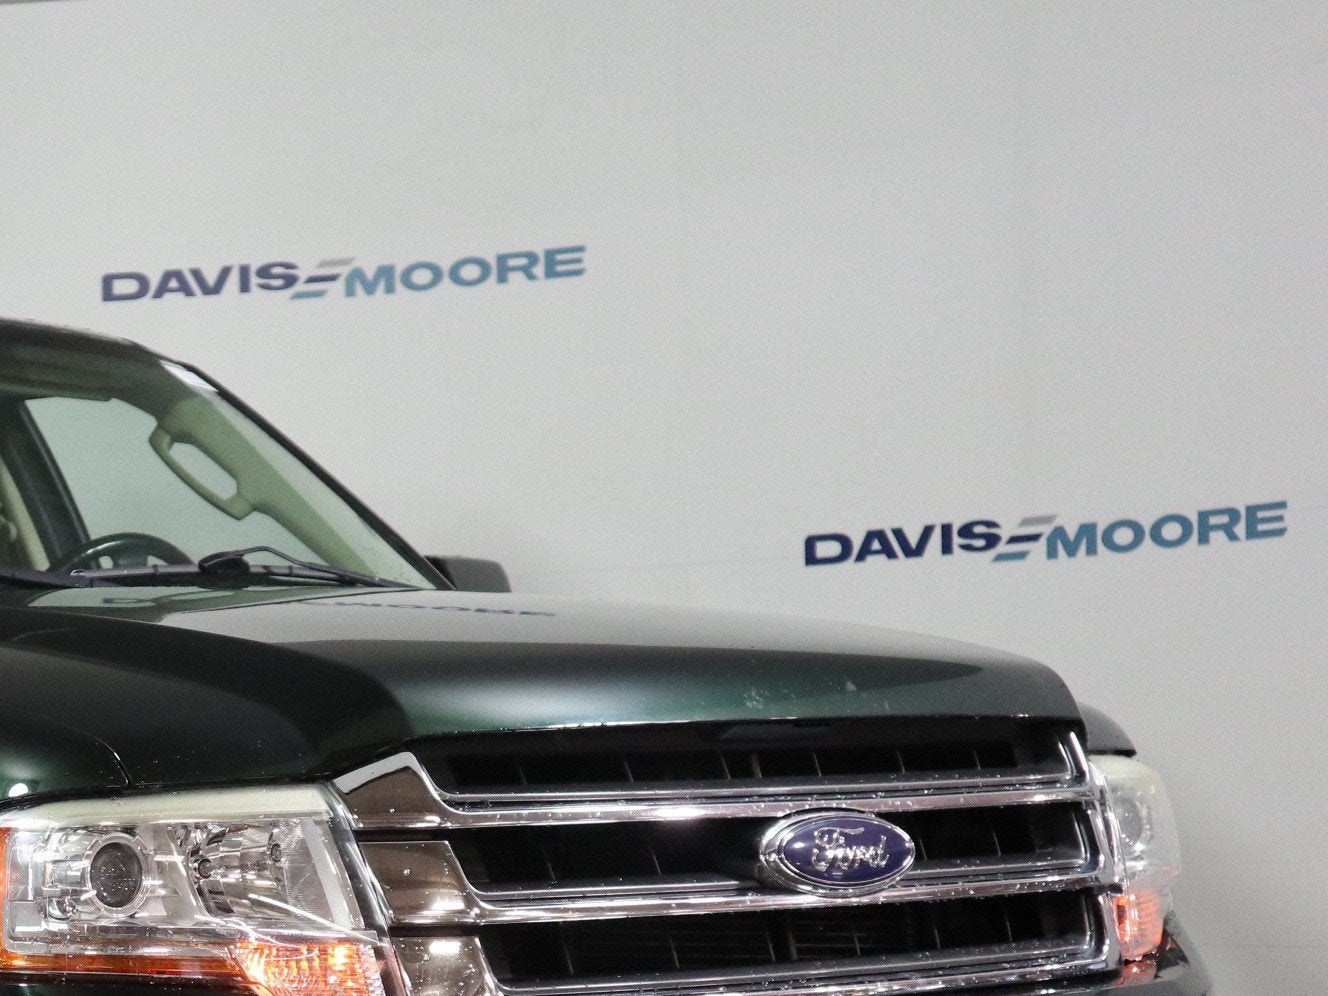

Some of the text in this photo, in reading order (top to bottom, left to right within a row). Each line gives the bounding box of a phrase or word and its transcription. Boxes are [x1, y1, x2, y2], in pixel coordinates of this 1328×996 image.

[101, 244, 588, 303] DAVIS MOORE
[803, 499, 1288, 568] DAVIS MOORE
[812, 826, 890, 872] Ford
